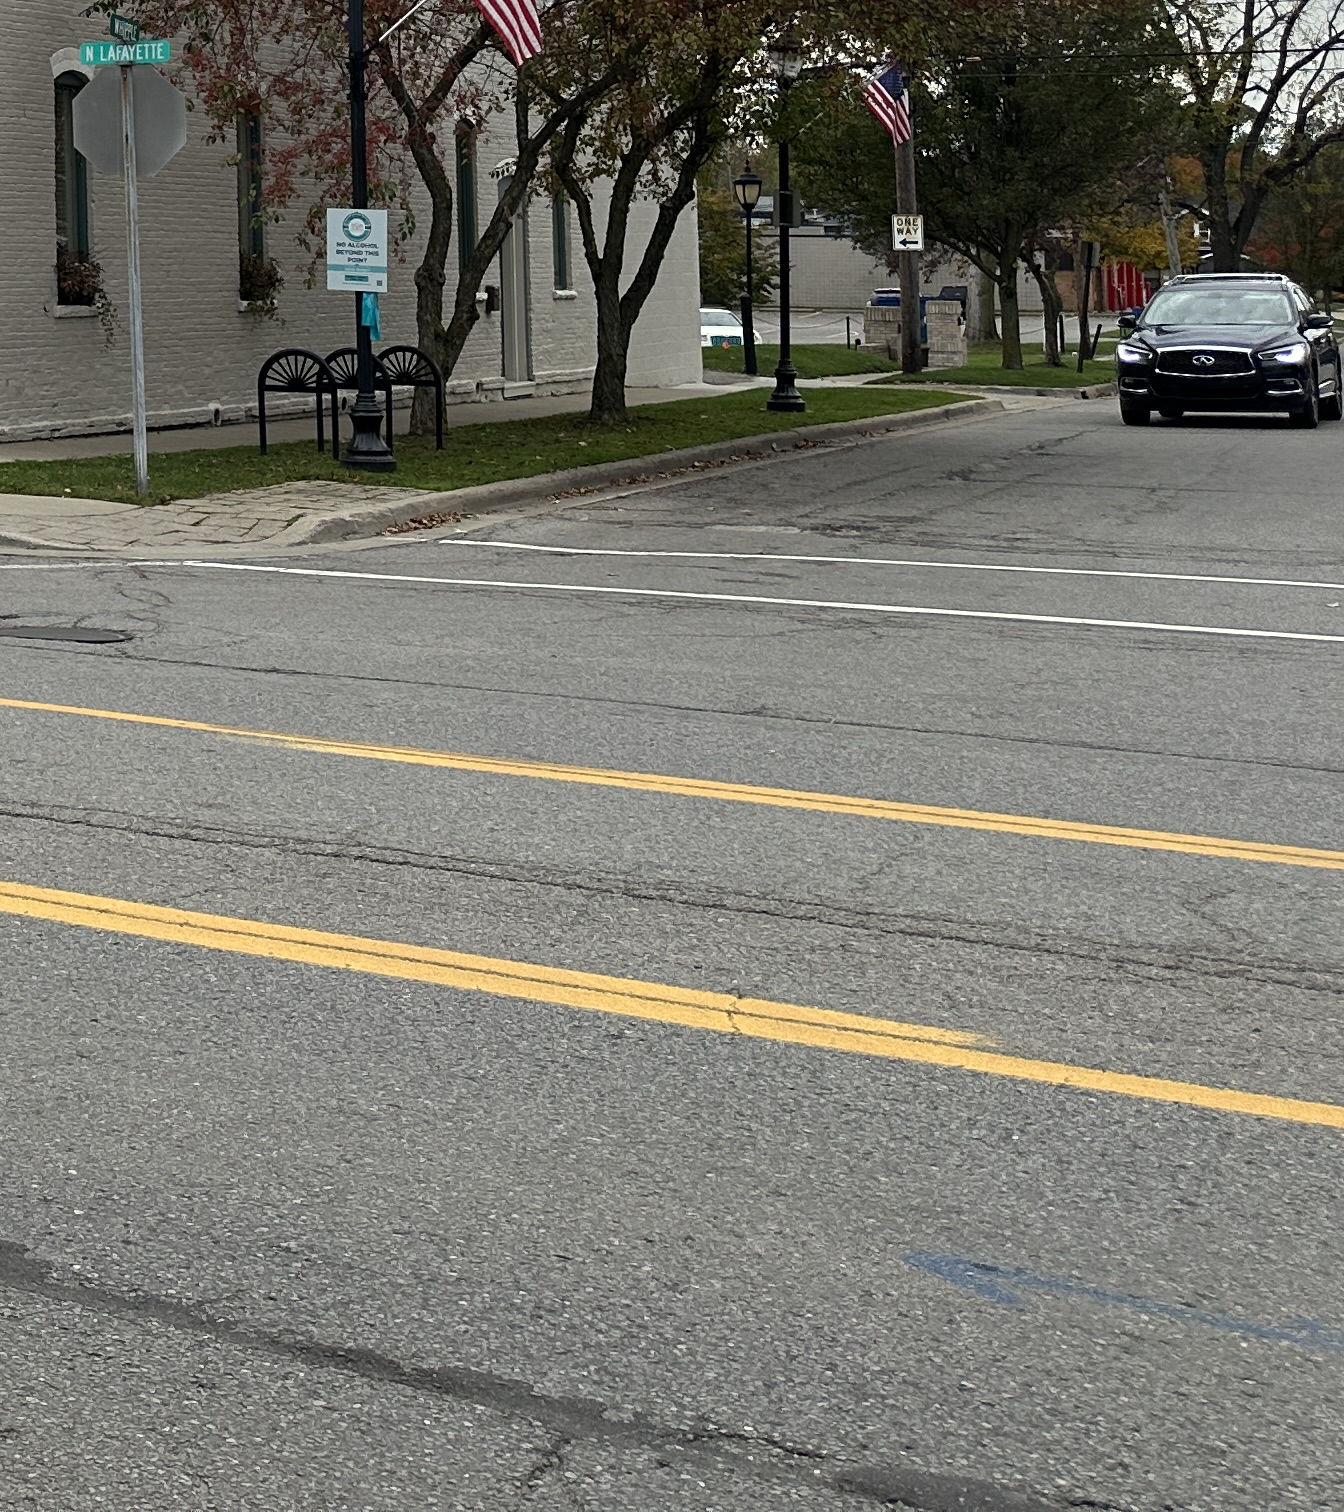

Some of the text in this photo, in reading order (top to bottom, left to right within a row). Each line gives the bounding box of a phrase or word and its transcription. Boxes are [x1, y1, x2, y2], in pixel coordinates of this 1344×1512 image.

[85, 42, 165, 62] N LAFAYETTE
[897, 218, 918, 226] ONE
[896, 227, 919, 235] WAY
